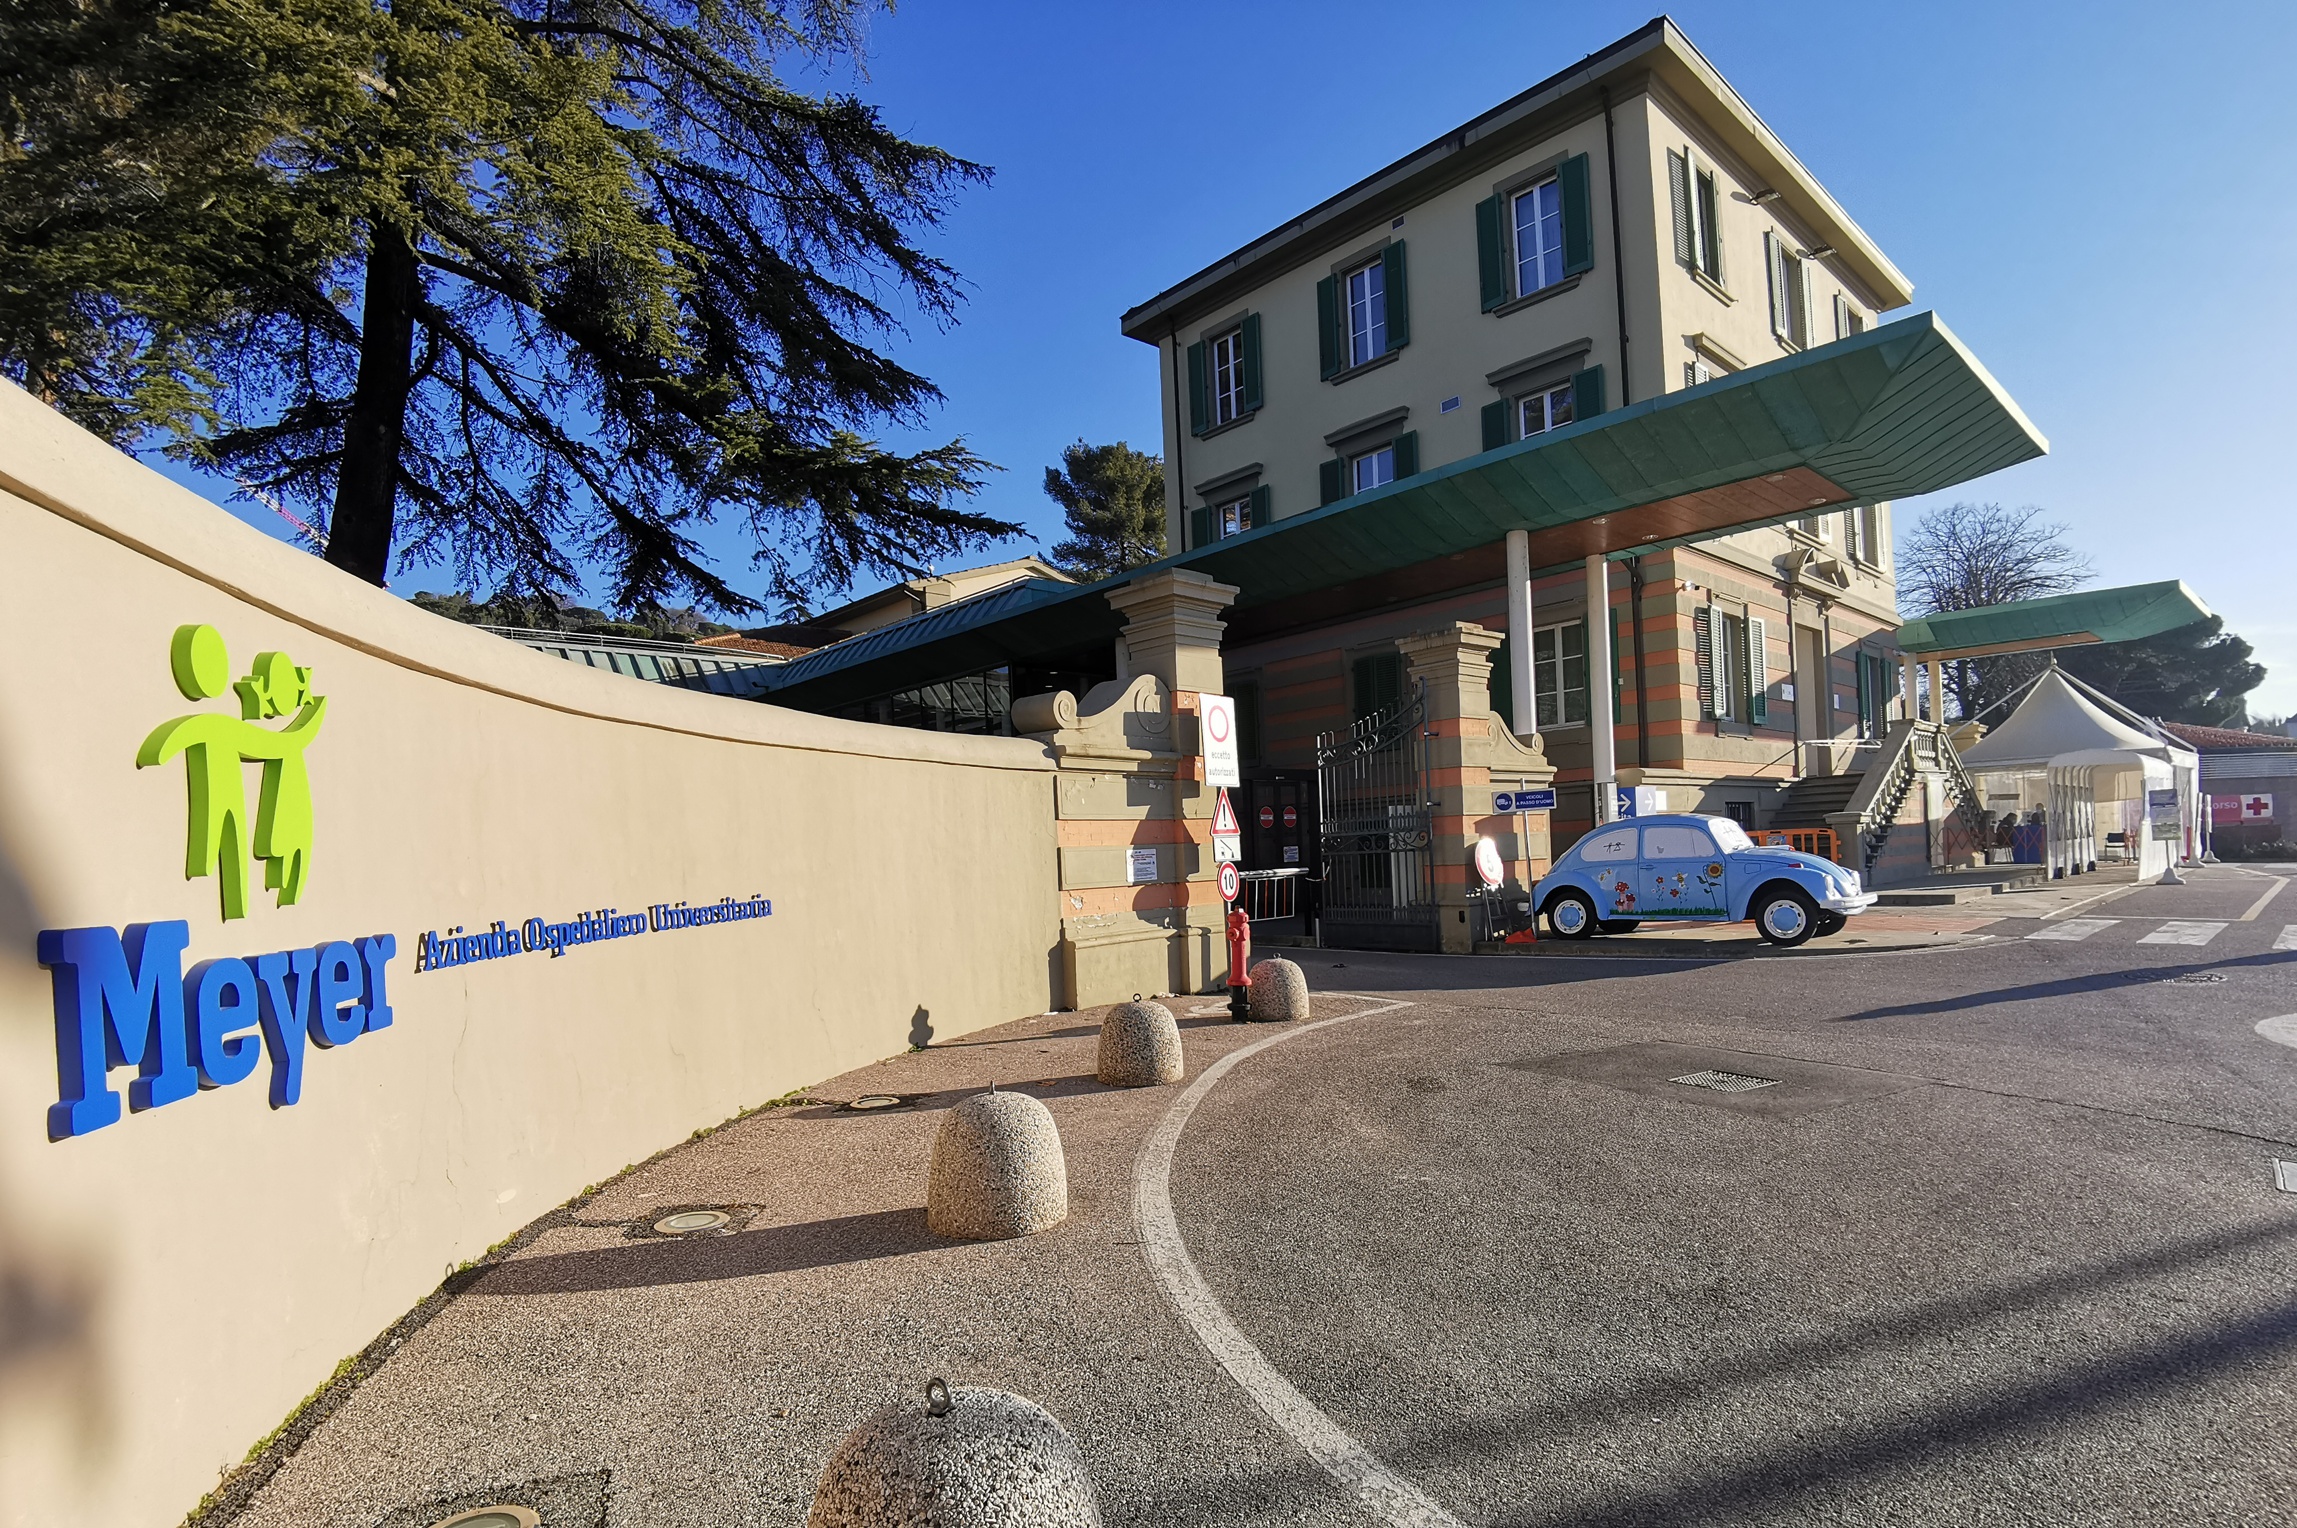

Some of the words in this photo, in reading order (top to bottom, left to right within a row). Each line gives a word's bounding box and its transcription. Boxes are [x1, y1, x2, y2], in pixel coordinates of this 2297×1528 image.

[1211, 750, 1231, 760] eccetto
[1208, 766, 1236, 777] autorizzati
[2212, 801, 2238, 810] orso
[1223, 873, 1234, 891] 10
[417, 921, 522, 973] Azienda
[523, 908, 647, 958] Ospedaliero
[650, 895, 772, 932] Universitaria
[37, 920, 396, 1141] Meyer
